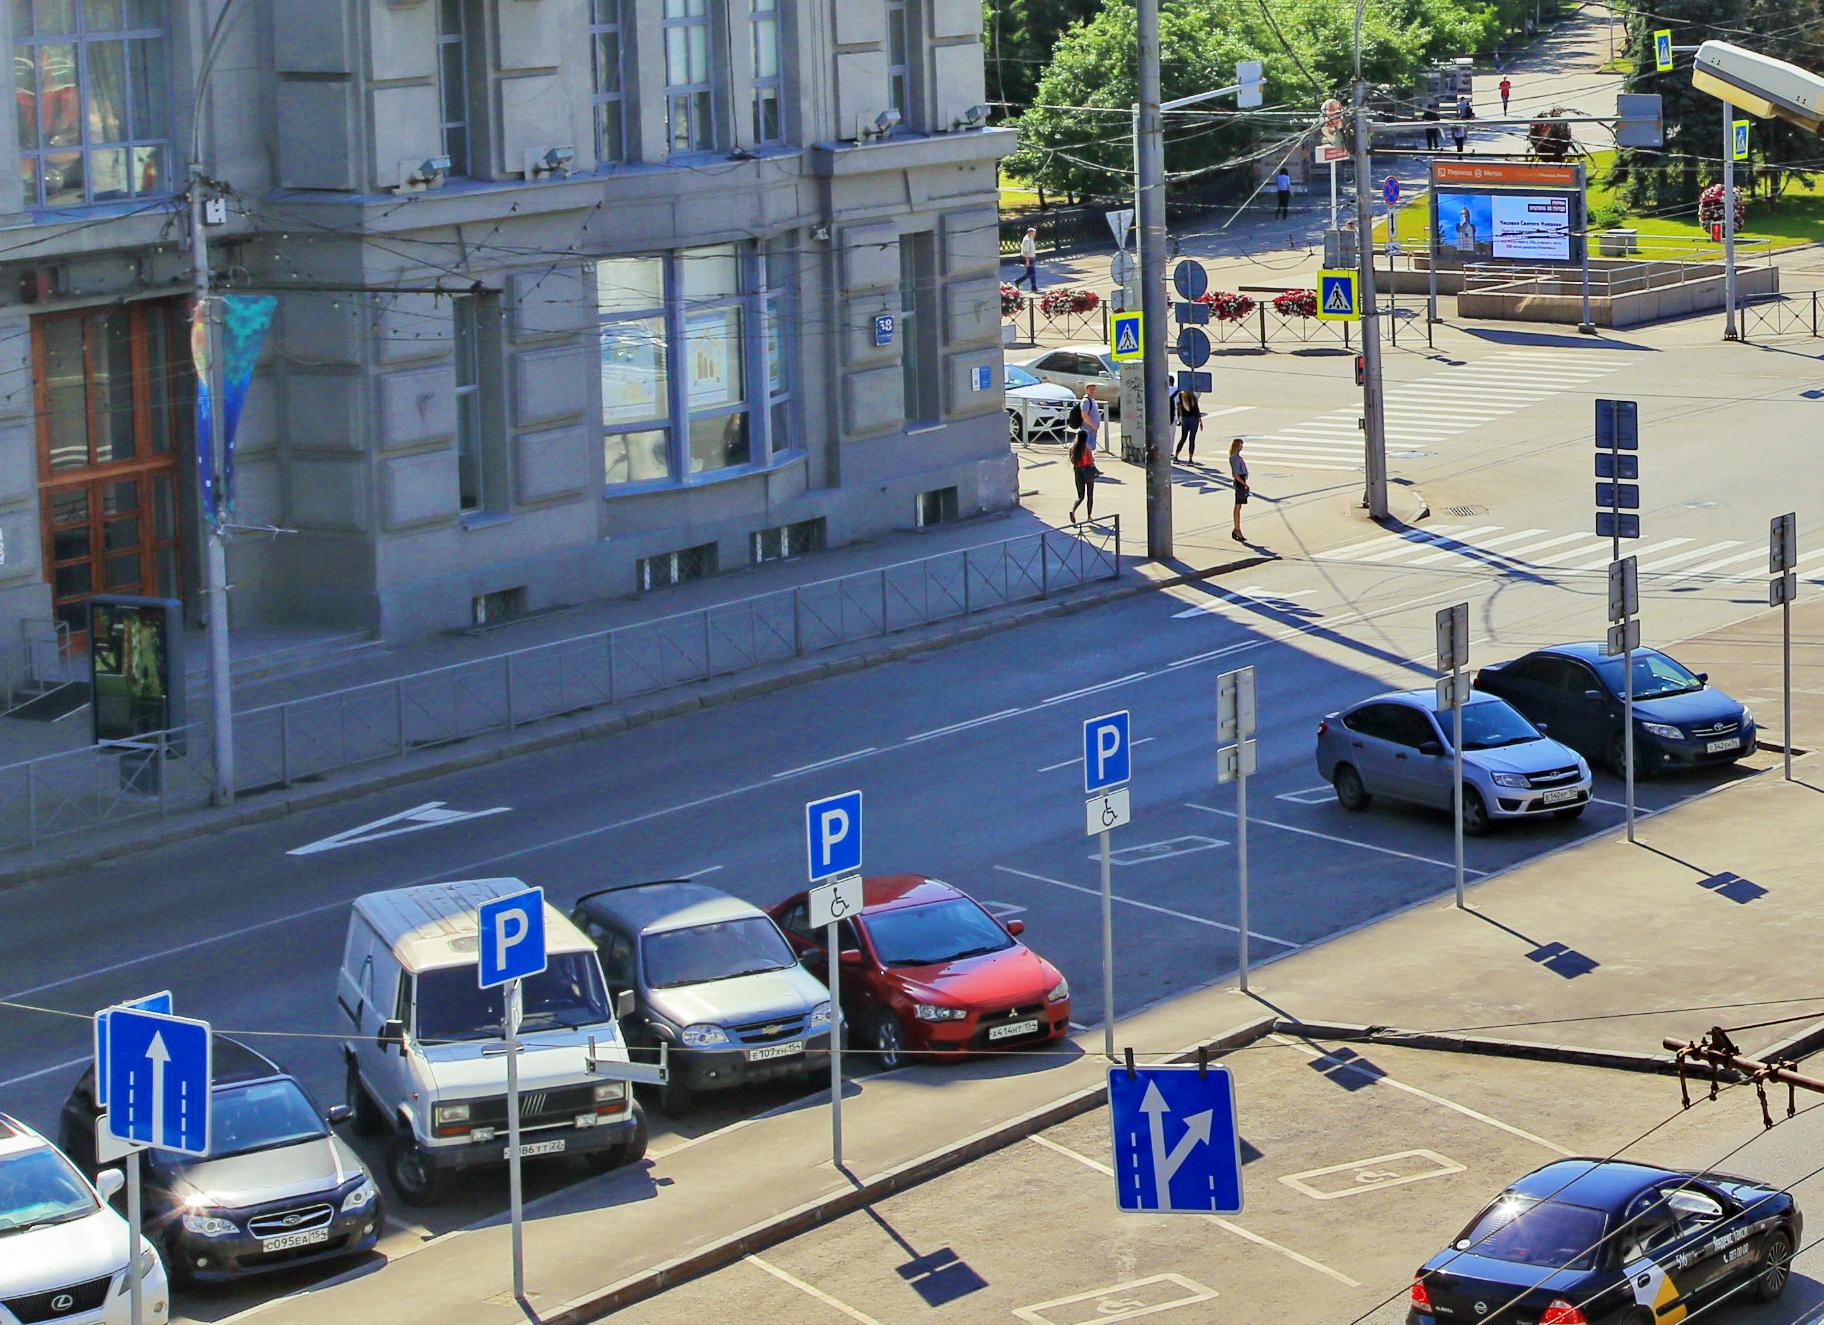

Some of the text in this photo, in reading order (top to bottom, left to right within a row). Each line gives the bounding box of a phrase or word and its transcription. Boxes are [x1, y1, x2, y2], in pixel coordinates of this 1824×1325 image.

[1097, 725, 1120, 780] P
[821, 808, 849, 866] P
[495, 908, 529, 972] P
